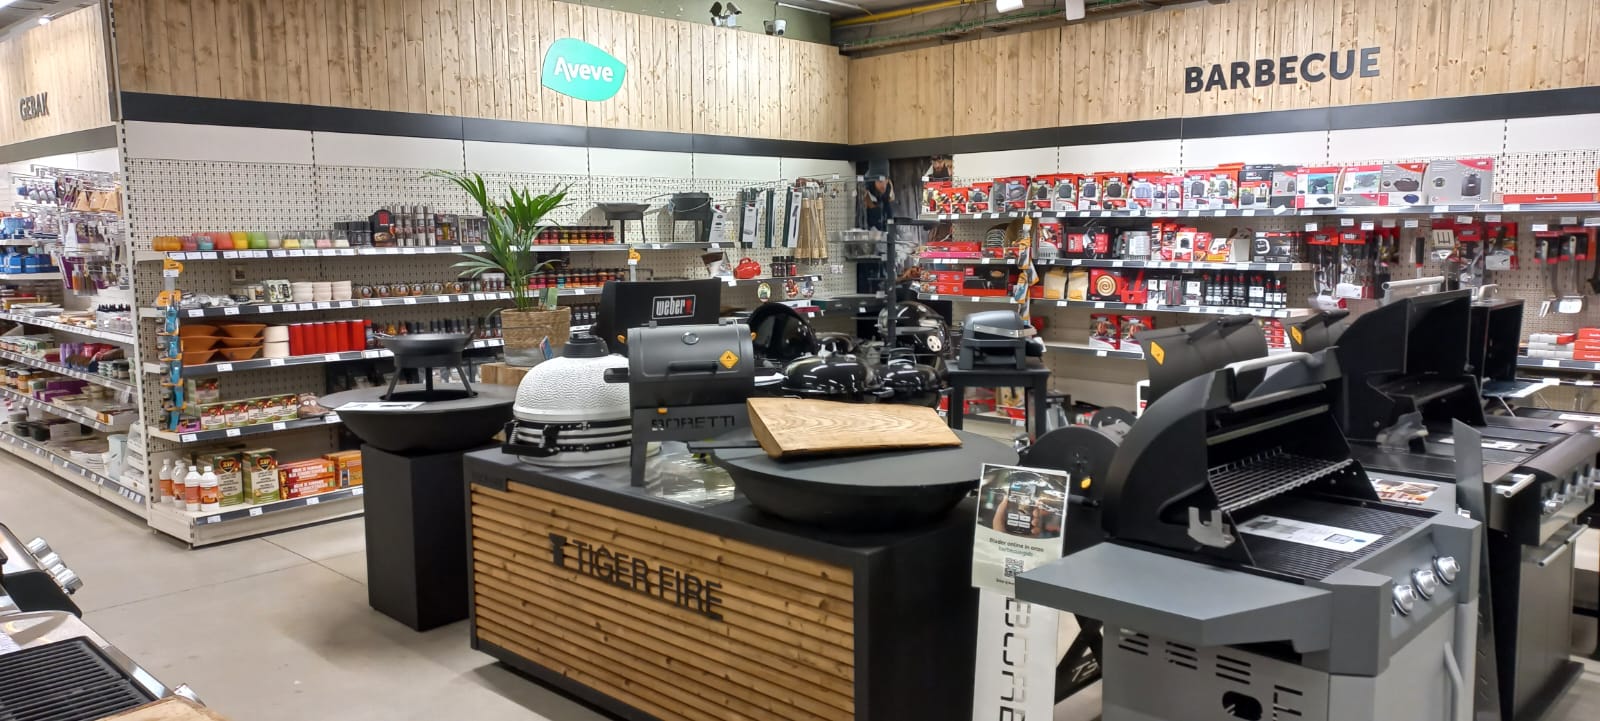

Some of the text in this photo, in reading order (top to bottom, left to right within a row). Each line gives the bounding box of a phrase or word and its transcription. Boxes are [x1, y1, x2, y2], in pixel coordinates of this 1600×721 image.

[553, 56, 614, 83] Aveve
[1184, 47, 1381, 93] BARBECUE
[20, 91, 49, 121] GEBAK
[656, 297, 686, 316] weber
[651, 415, 735, 431] BORETTI
[572, 539, 723, 622] TIGER FIRE
